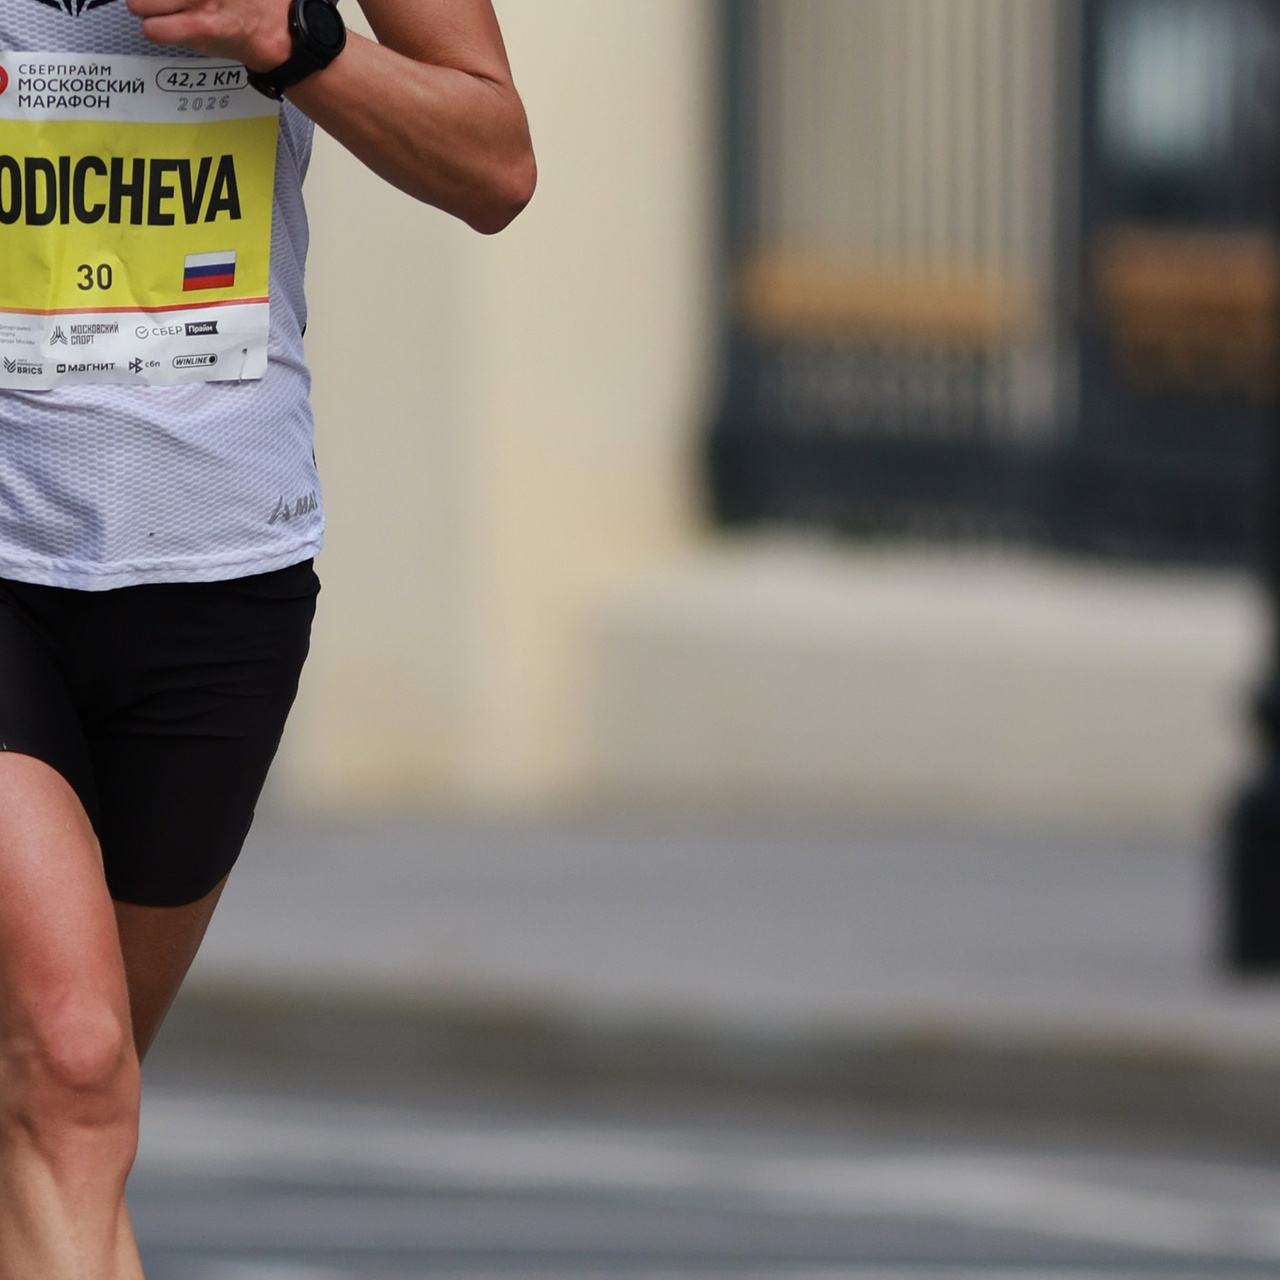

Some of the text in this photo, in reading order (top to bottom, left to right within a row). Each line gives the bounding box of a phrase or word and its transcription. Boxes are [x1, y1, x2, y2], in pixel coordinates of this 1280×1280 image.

[18, 63, 112, 76] СБЕРПРАЙМ
[18, 78, 145, 94] МОСКОВСКИЙ
[166, 72, 207, 89] 42,2
[18, 94, 110, 109] МАРАФОН
[177, 95, 230, 111] 2026
[76, 263, 113, 291] 30
[70, 322, 120, 335] МОСКОВСКИЙ
[152, 325, 183, 337] СБЕР
[70, 335, 95, 346] СПОРТ
[175, 356, 209, 366] WINLINE
[17, 366, 43, 375] BRICS
